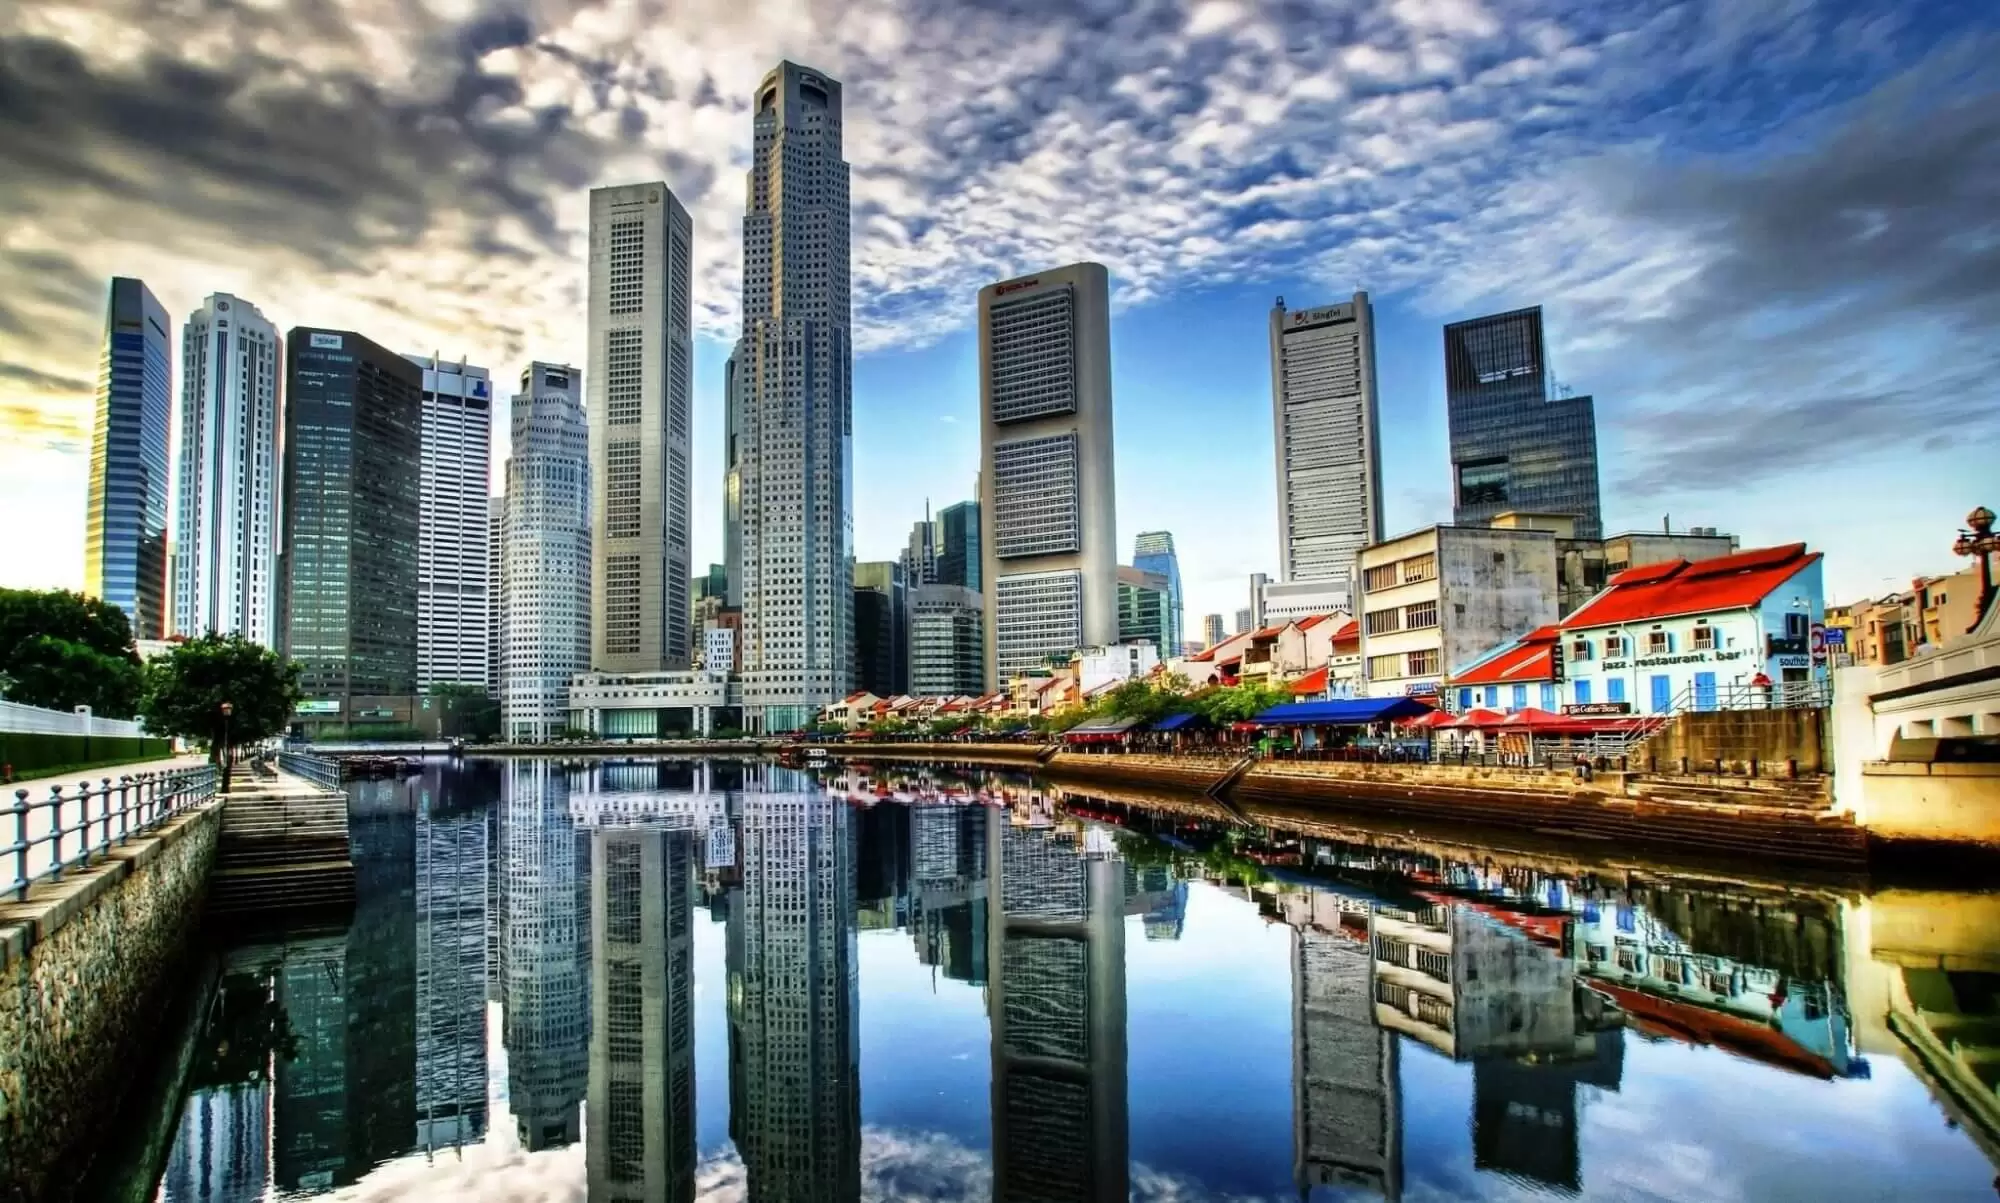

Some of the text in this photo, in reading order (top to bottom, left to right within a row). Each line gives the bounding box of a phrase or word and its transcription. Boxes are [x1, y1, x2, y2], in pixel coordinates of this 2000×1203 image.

[1602, 651, 1740, 671] jazz restaurant bar
